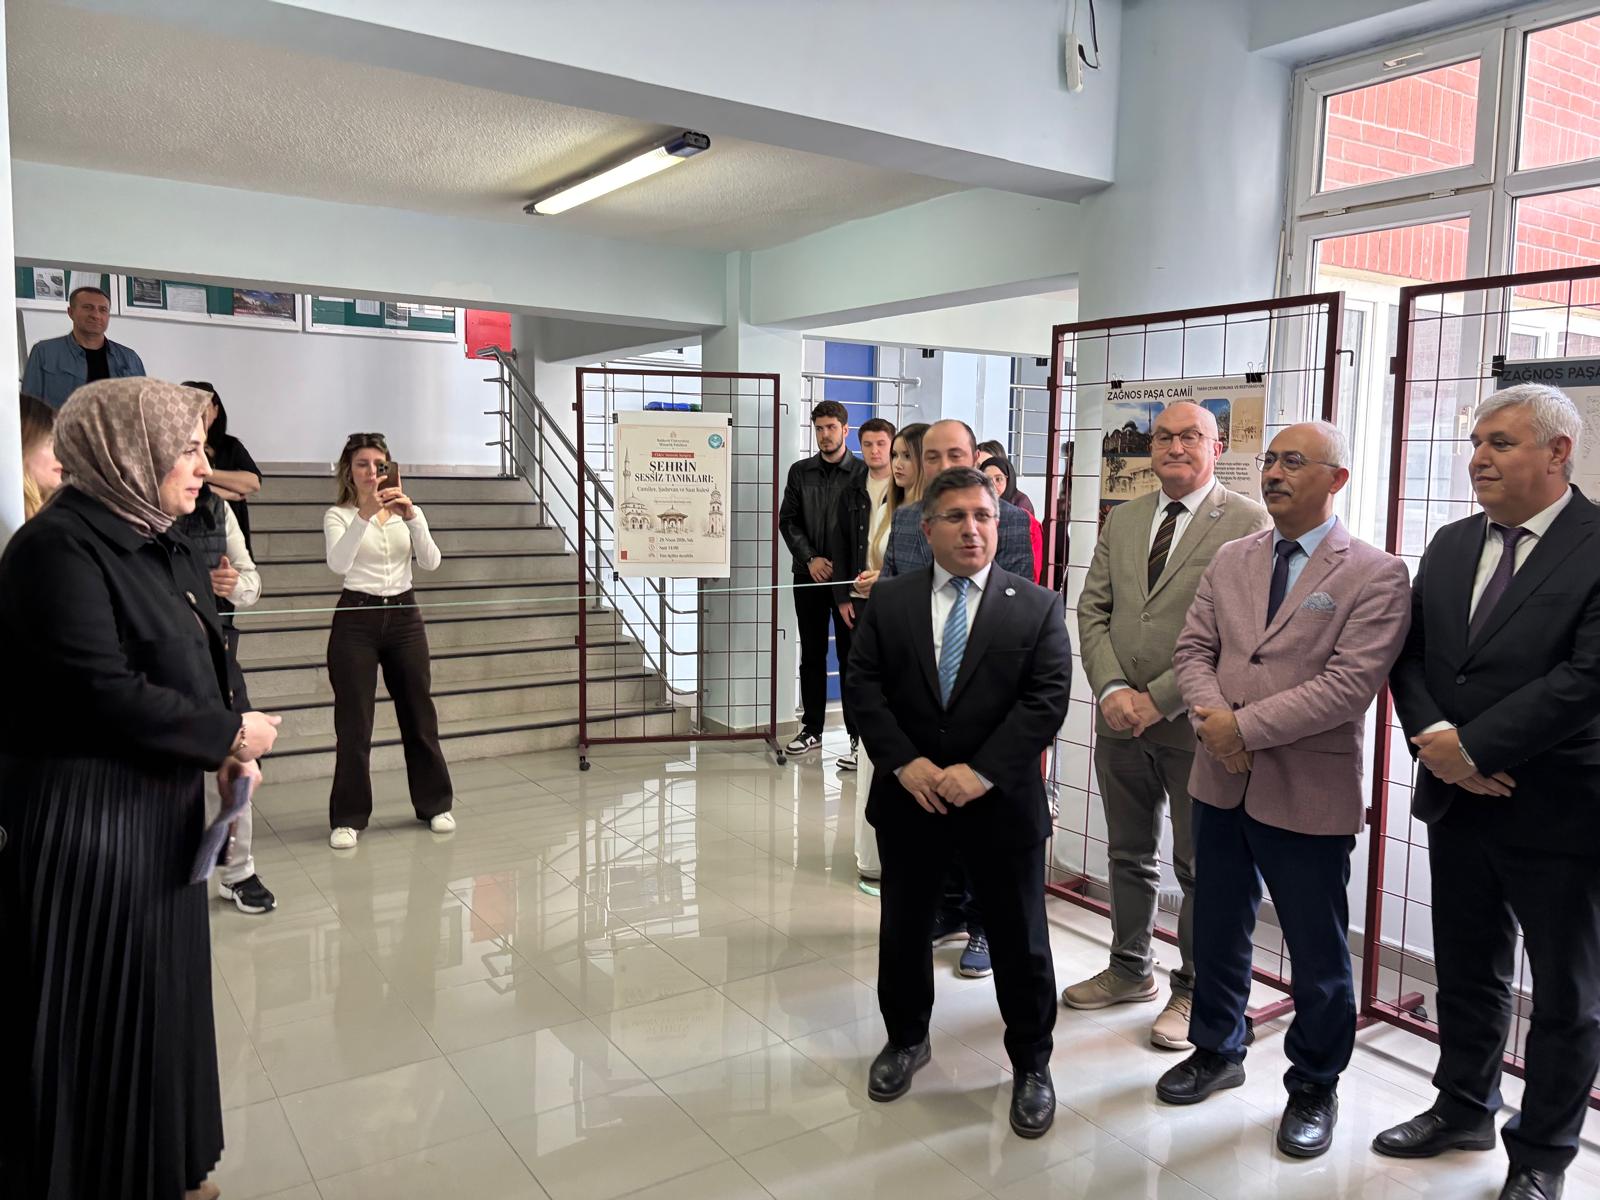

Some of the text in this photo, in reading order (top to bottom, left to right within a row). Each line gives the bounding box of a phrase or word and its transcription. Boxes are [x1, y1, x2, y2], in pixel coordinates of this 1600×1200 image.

[1503, 368, 1563, 382] ZAĞNOS
[1107, 385, 1193, 401] ZAĞNOS PAŞA CAMİİ
[649, 459, 697, 474] ŞEHRİN
[634, 472, 714, 484] SESSİZ TANIKLARI:
